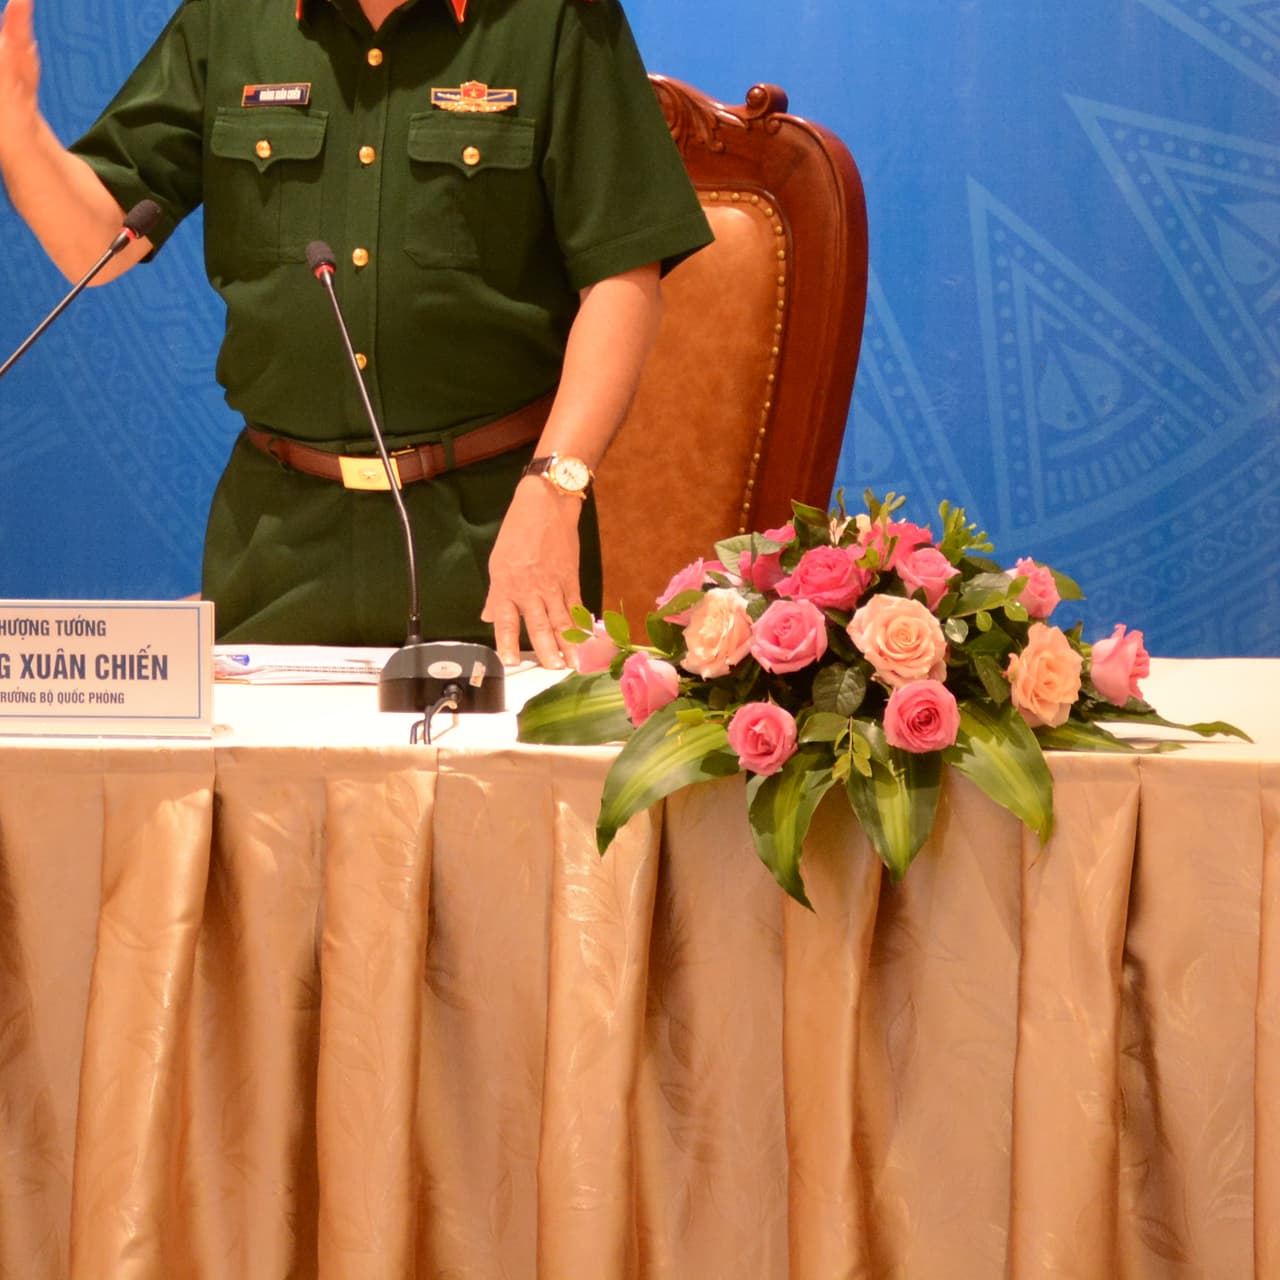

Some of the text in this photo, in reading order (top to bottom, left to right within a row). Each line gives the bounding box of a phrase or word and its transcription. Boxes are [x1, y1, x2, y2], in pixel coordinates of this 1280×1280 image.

[55, 615, 106, 636] TƯỚNG
[20, 648, 86, 680] XUÂN
[94, 644, 168, 681] CHIẾN
[39, 689, 54, 706] BỘ
[57, 688, 85, 704] QUỐC
